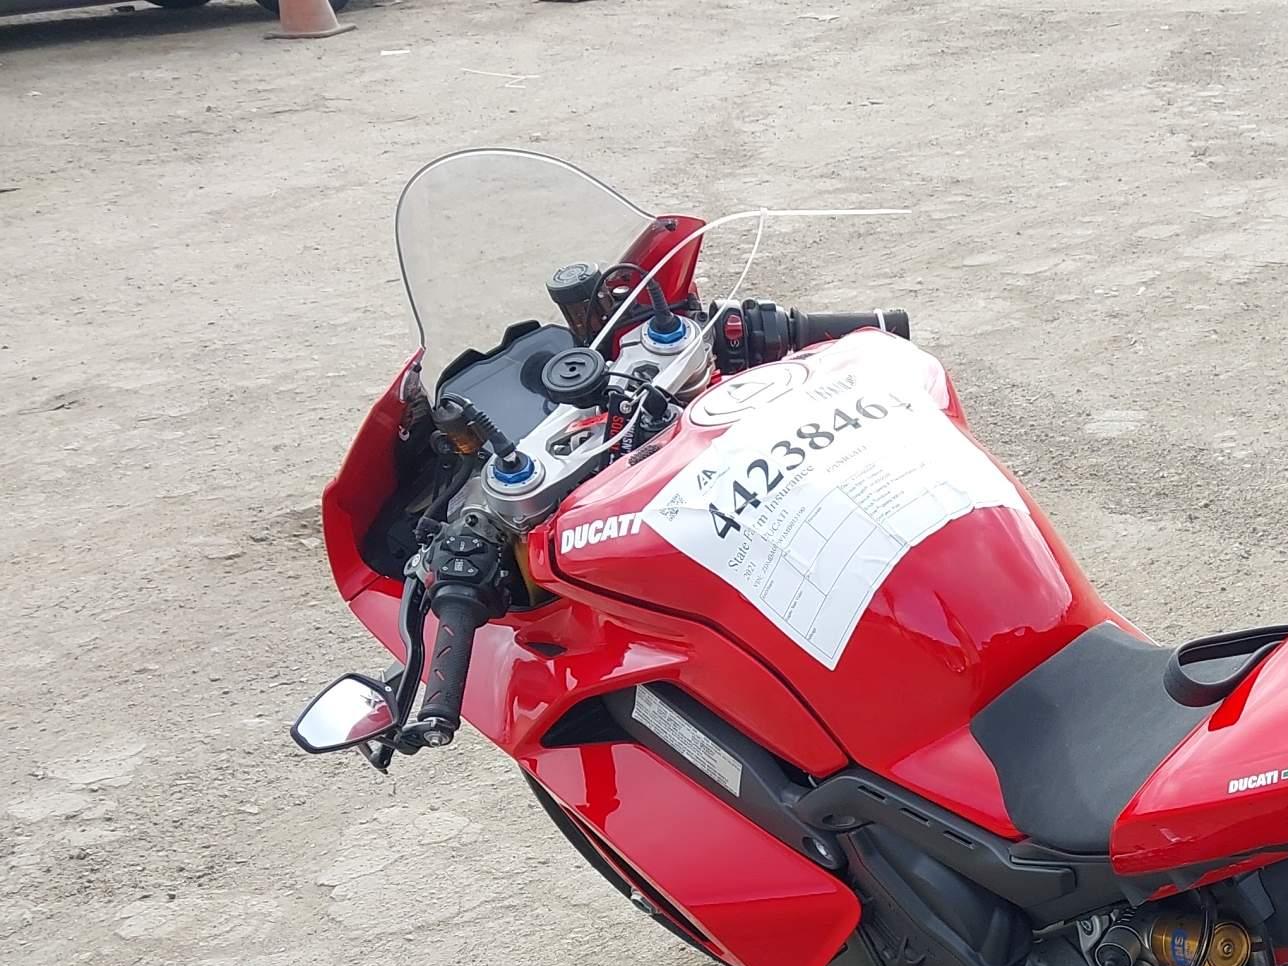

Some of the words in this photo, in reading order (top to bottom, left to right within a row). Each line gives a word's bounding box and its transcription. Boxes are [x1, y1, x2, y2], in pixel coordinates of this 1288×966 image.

[561, 512, 642, 555] DUCATI
[728, 542, 751, 572] State
[742, 513, 769, 543] Farm
[764, 464, 815, 513] Insurance
[1228, 770, 1278, 794] DUCATI
